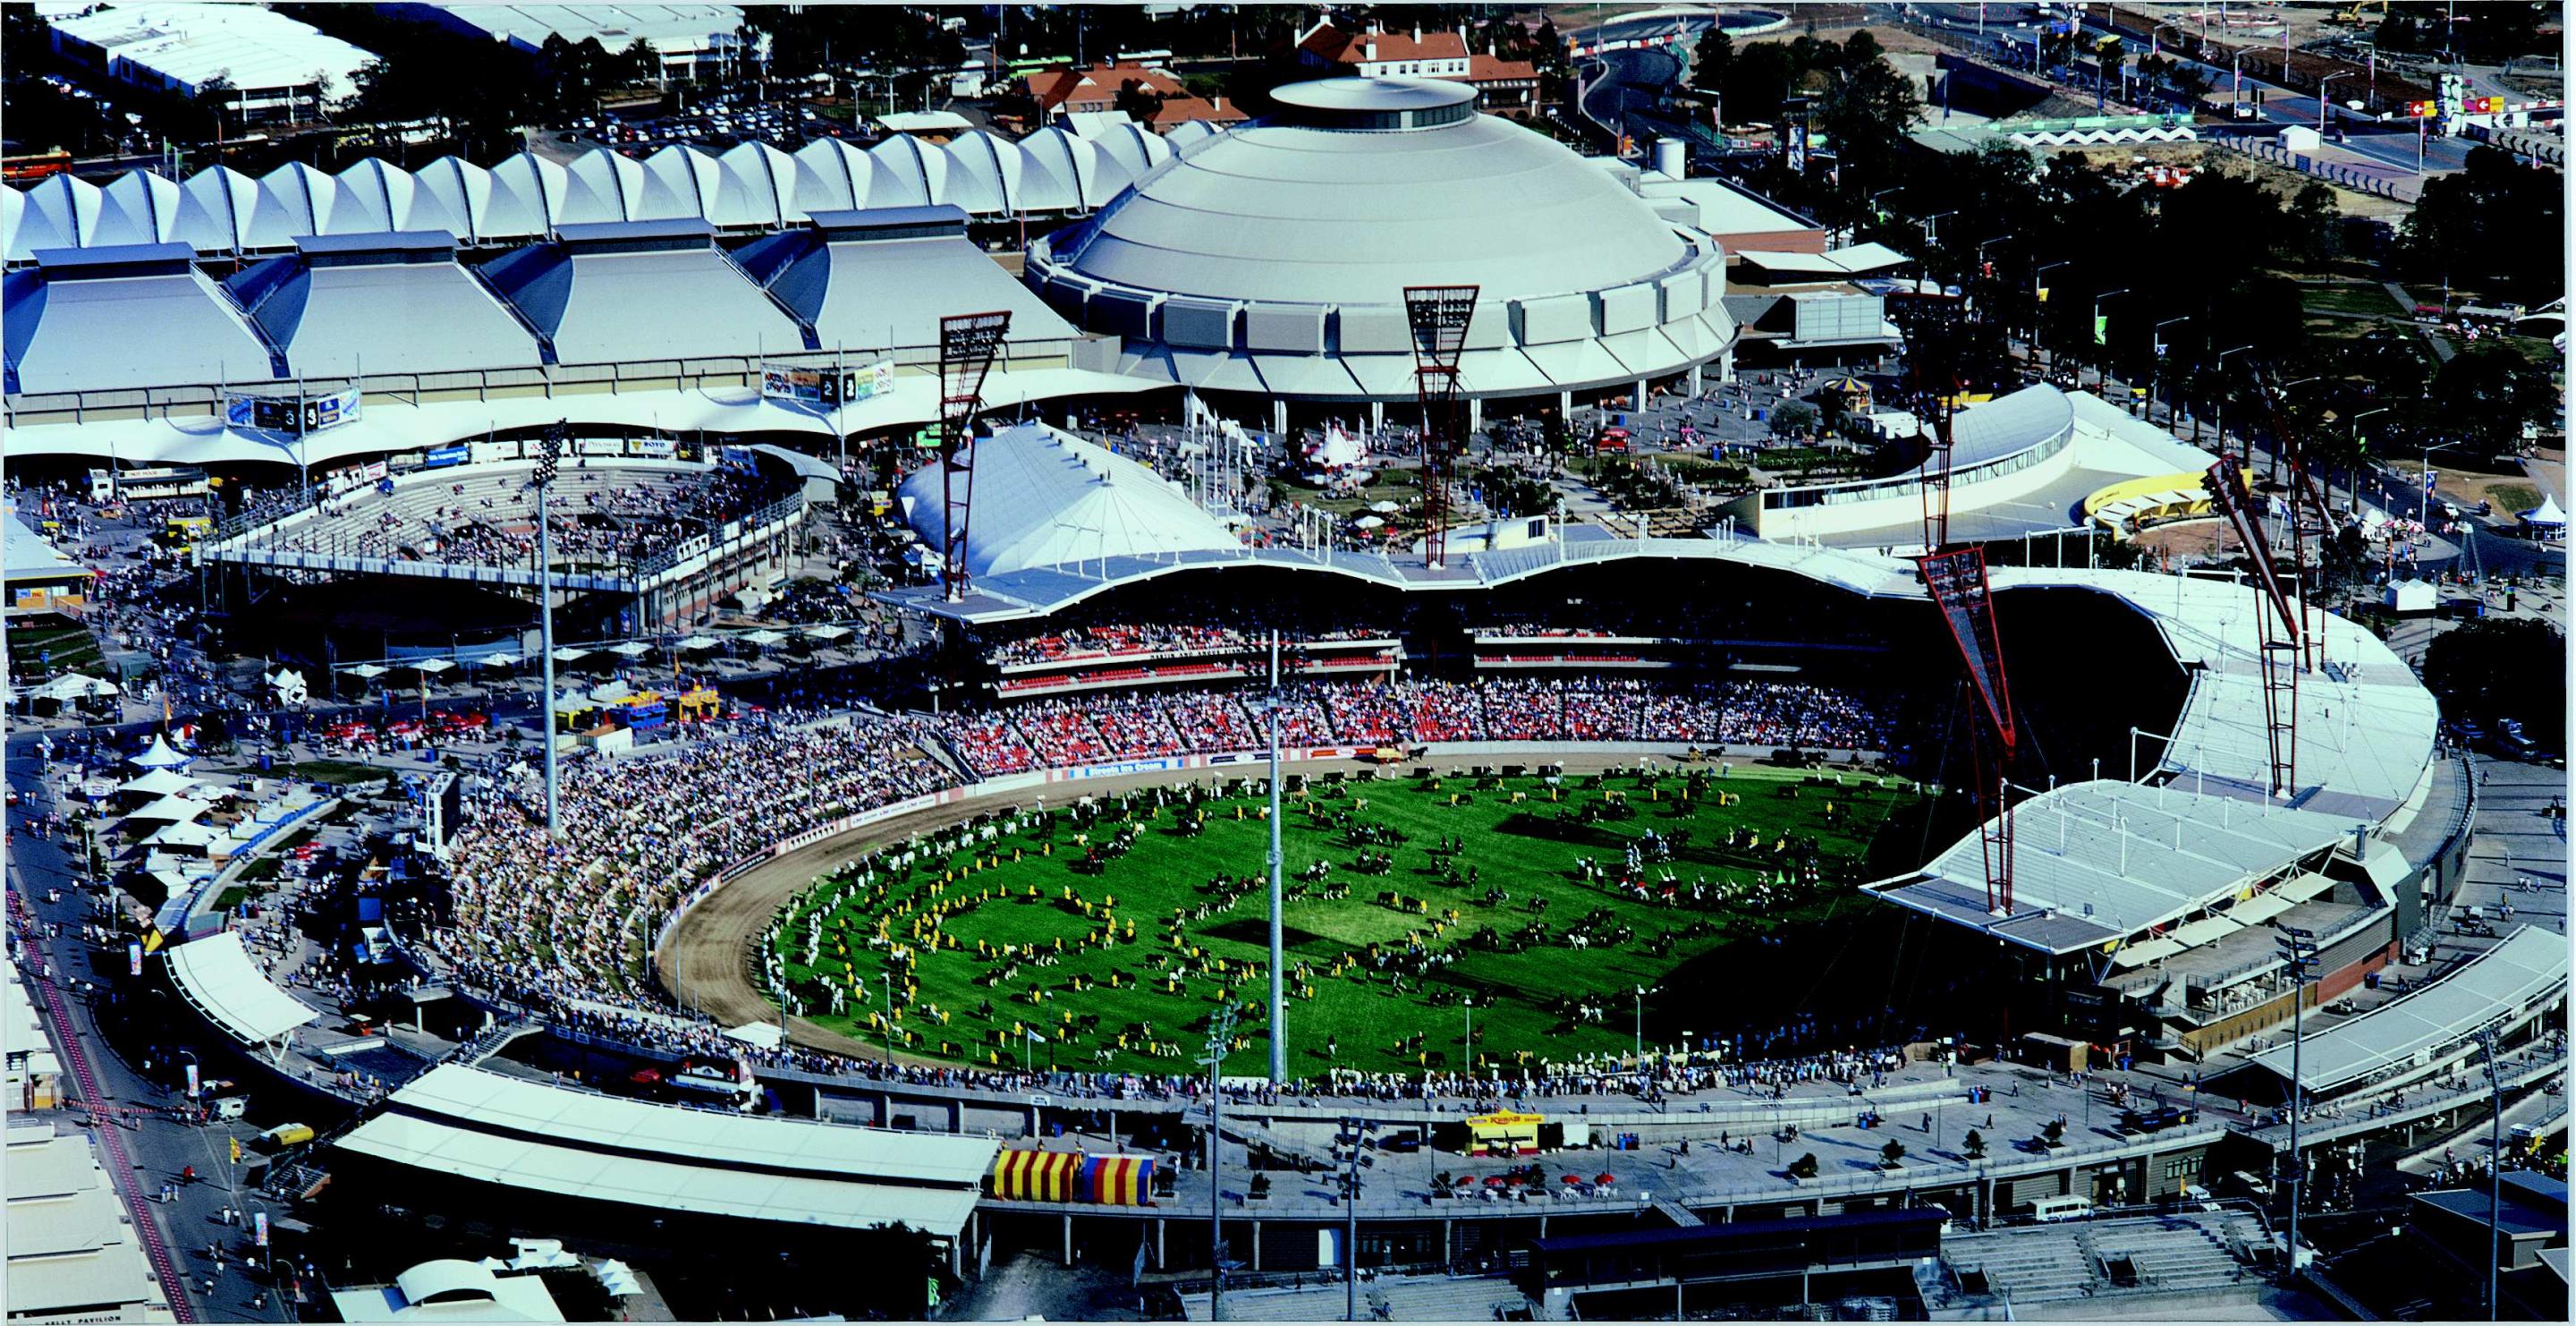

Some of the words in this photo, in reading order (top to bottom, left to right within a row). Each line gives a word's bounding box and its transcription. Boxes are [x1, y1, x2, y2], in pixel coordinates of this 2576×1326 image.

[824, 383, 833, 396] 2
[285, 412, 295, 425] 3
[1089, 766, 1119, 778] Streets
[1120, 764, 1134, 775] Ice
[1135, 761, 1163, 772] Cream
[79, 1315, 121, 1323] PAVILION
